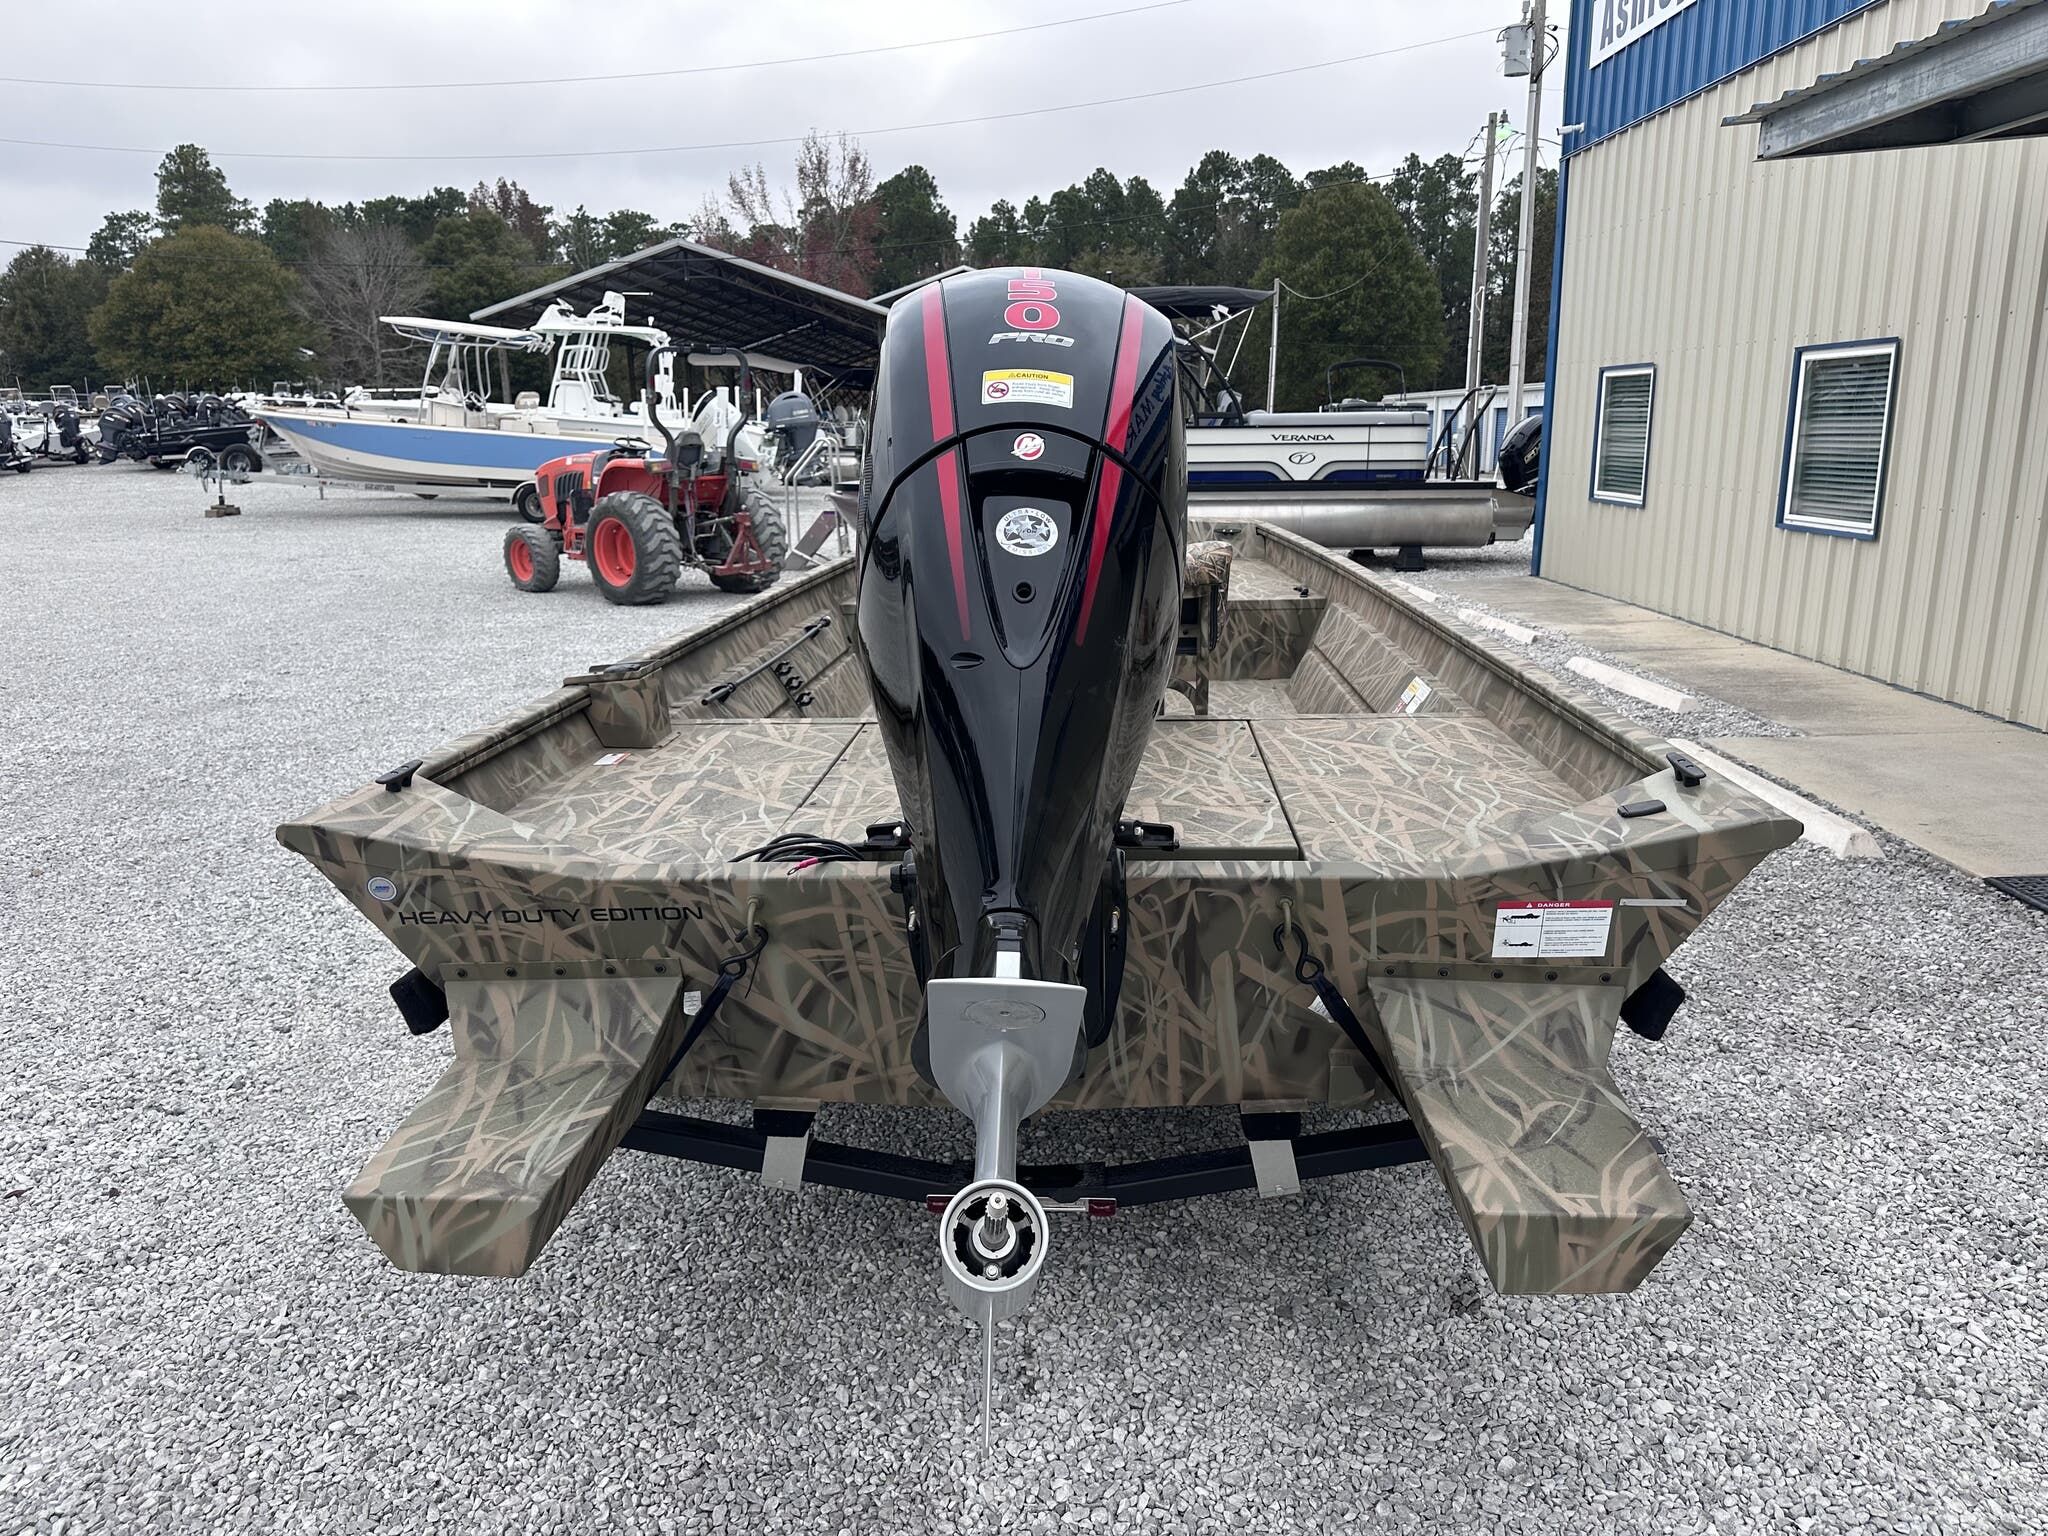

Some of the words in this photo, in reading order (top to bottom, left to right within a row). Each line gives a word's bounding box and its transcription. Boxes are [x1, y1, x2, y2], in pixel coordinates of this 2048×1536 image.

[988, 332, 1075, 347] PRO
[1271, 434, 1335, 442] VERANDA
[398, 910, 492, 925] HEAVY
[502, 909, 581, 923] DUTY
[591, 907, 704, 922] EDITION
